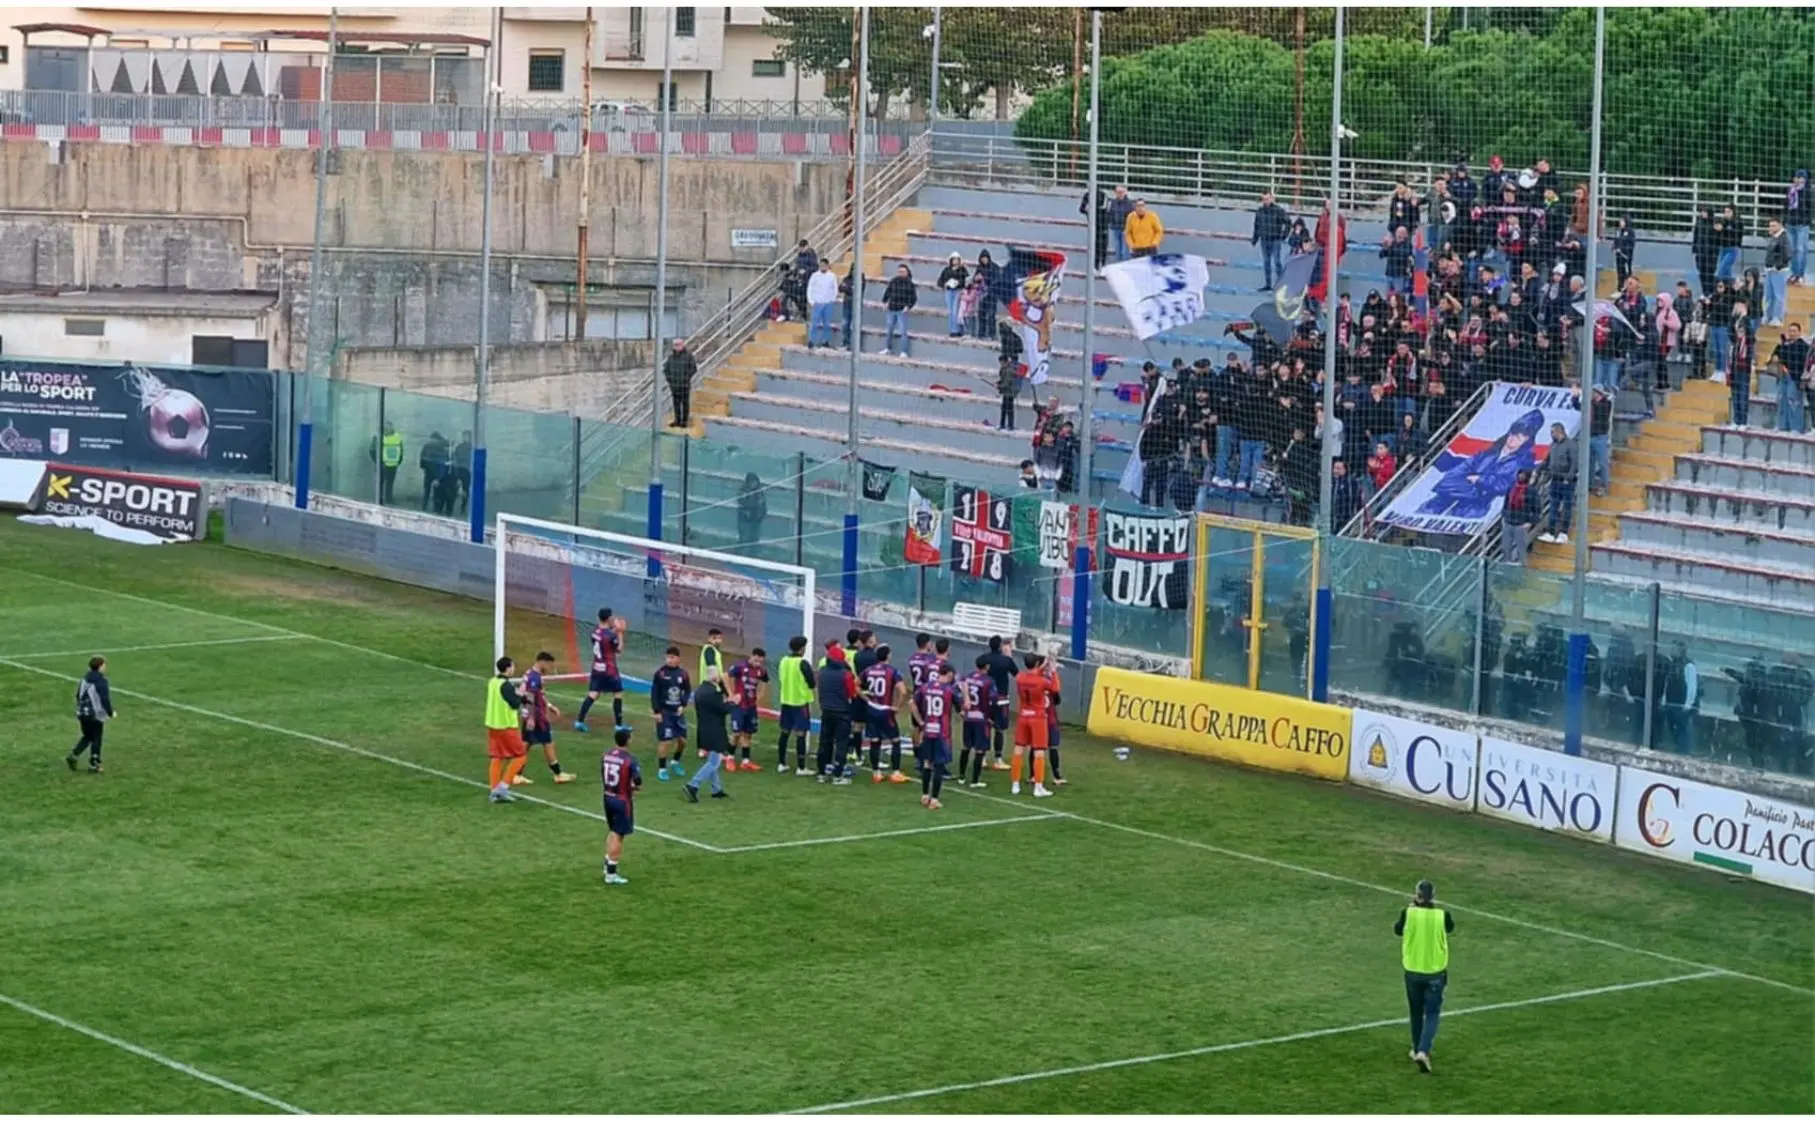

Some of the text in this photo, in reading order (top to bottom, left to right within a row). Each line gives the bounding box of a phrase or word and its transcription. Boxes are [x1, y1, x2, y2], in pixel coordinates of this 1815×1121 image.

[1, 370, 88, 386] LA "TROPEA"
[1, 382, 96, 401] PER LO SPORT
[1503, 386, 1556, 409] CURVA
[47, 473, 197, 516] K-SPORT
[45, 501, 194, 532] SCIENCE TO PERFORM
[994, 500, 1007, 528] 9
[1106, 512, 1190, 554] CAFFO
[989, 552, 1003, 581] 8
[1111, 557, 1175, 609] OUT
[866, 676, 887, 697] 20
[912, 666, 922, 686] 2
[924, 695, 945, 717] 19
[1103, 686, 1187, 730] VECCHIA
[1190, 703, 1268, 745] GRAPPA
[1271, 717, 1344, 758] CAFFO
[603, 762, 621, 787] 13
[1406, 735, 1602, 833] CUSANO
[1744, 799, 1789, 824] Panificio
